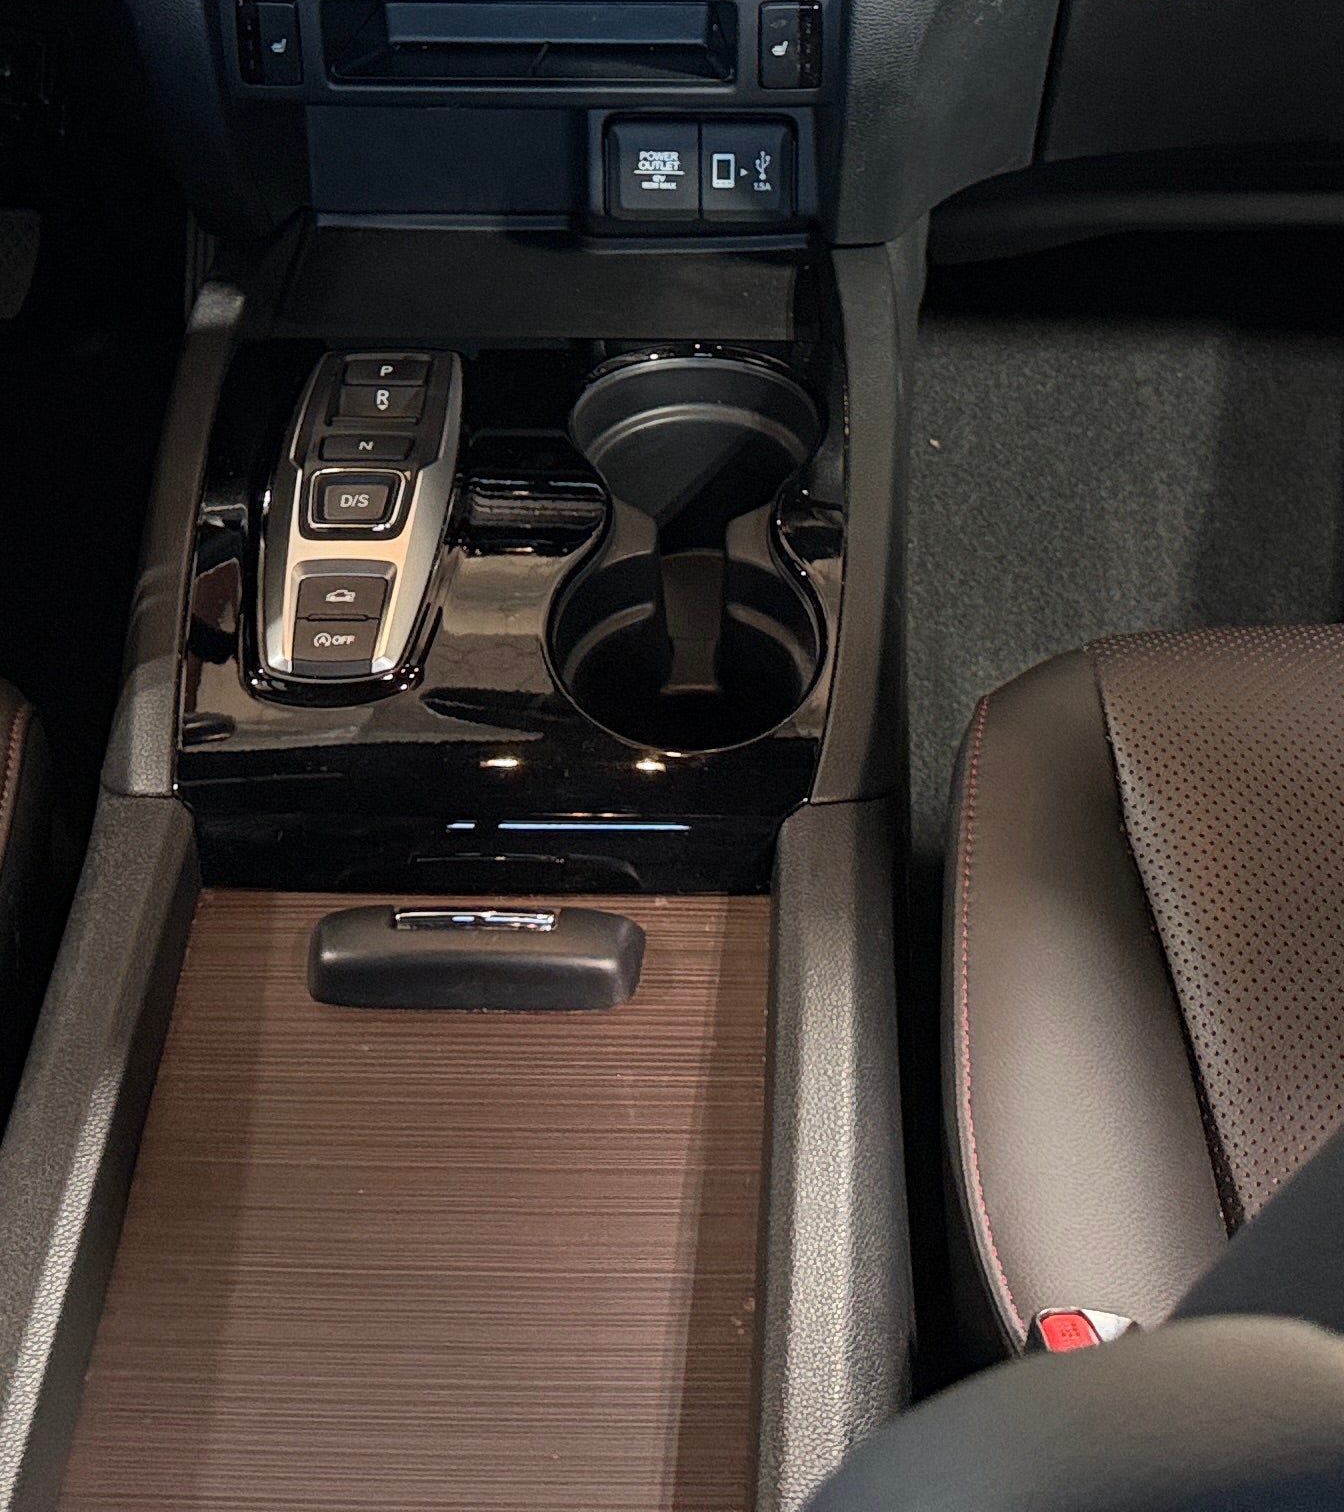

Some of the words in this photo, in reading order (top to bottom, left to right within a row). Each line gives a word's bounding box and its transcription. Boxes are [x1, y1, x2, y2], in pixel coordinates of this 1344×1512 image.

[639, 151, 679, 161] POWER
[638, 160, 681, 170] OUTLET
[379, 365, 394, 377] P
[376, 389, 390, 405] R
[358, 441, 374, 451] N
[340, 494, 369, 508] D/S
[332, 635, 355, 645] OFF
